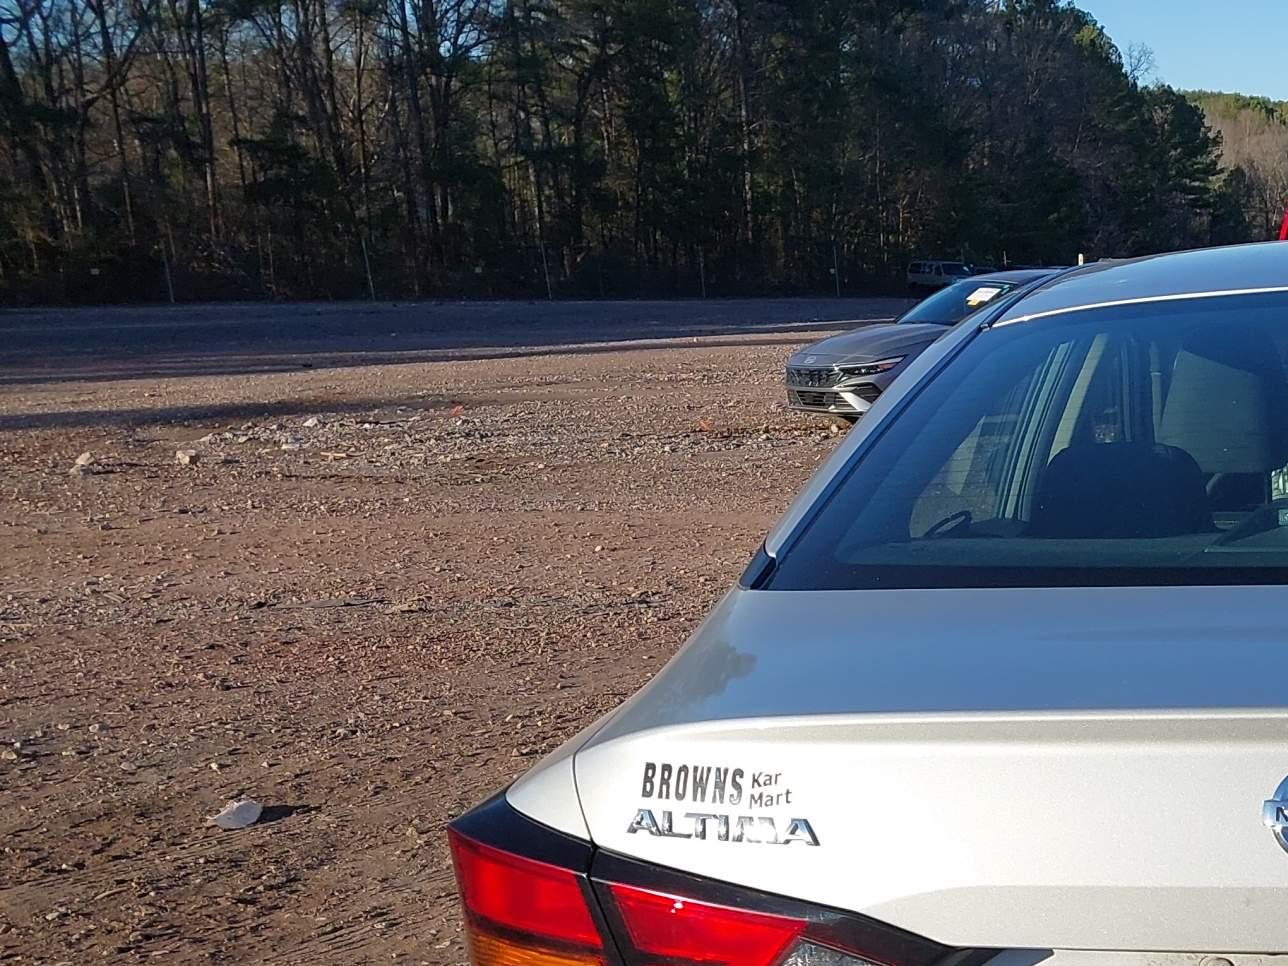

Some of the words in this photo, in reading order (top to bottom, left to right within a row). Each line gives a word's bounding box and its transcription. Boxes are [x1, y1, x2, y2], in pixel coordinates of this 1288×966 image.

[641, 761, 745, 806] BROWNS
[751, 771, 783, 790] Kar
[748, 788, 793, 810] Mart
